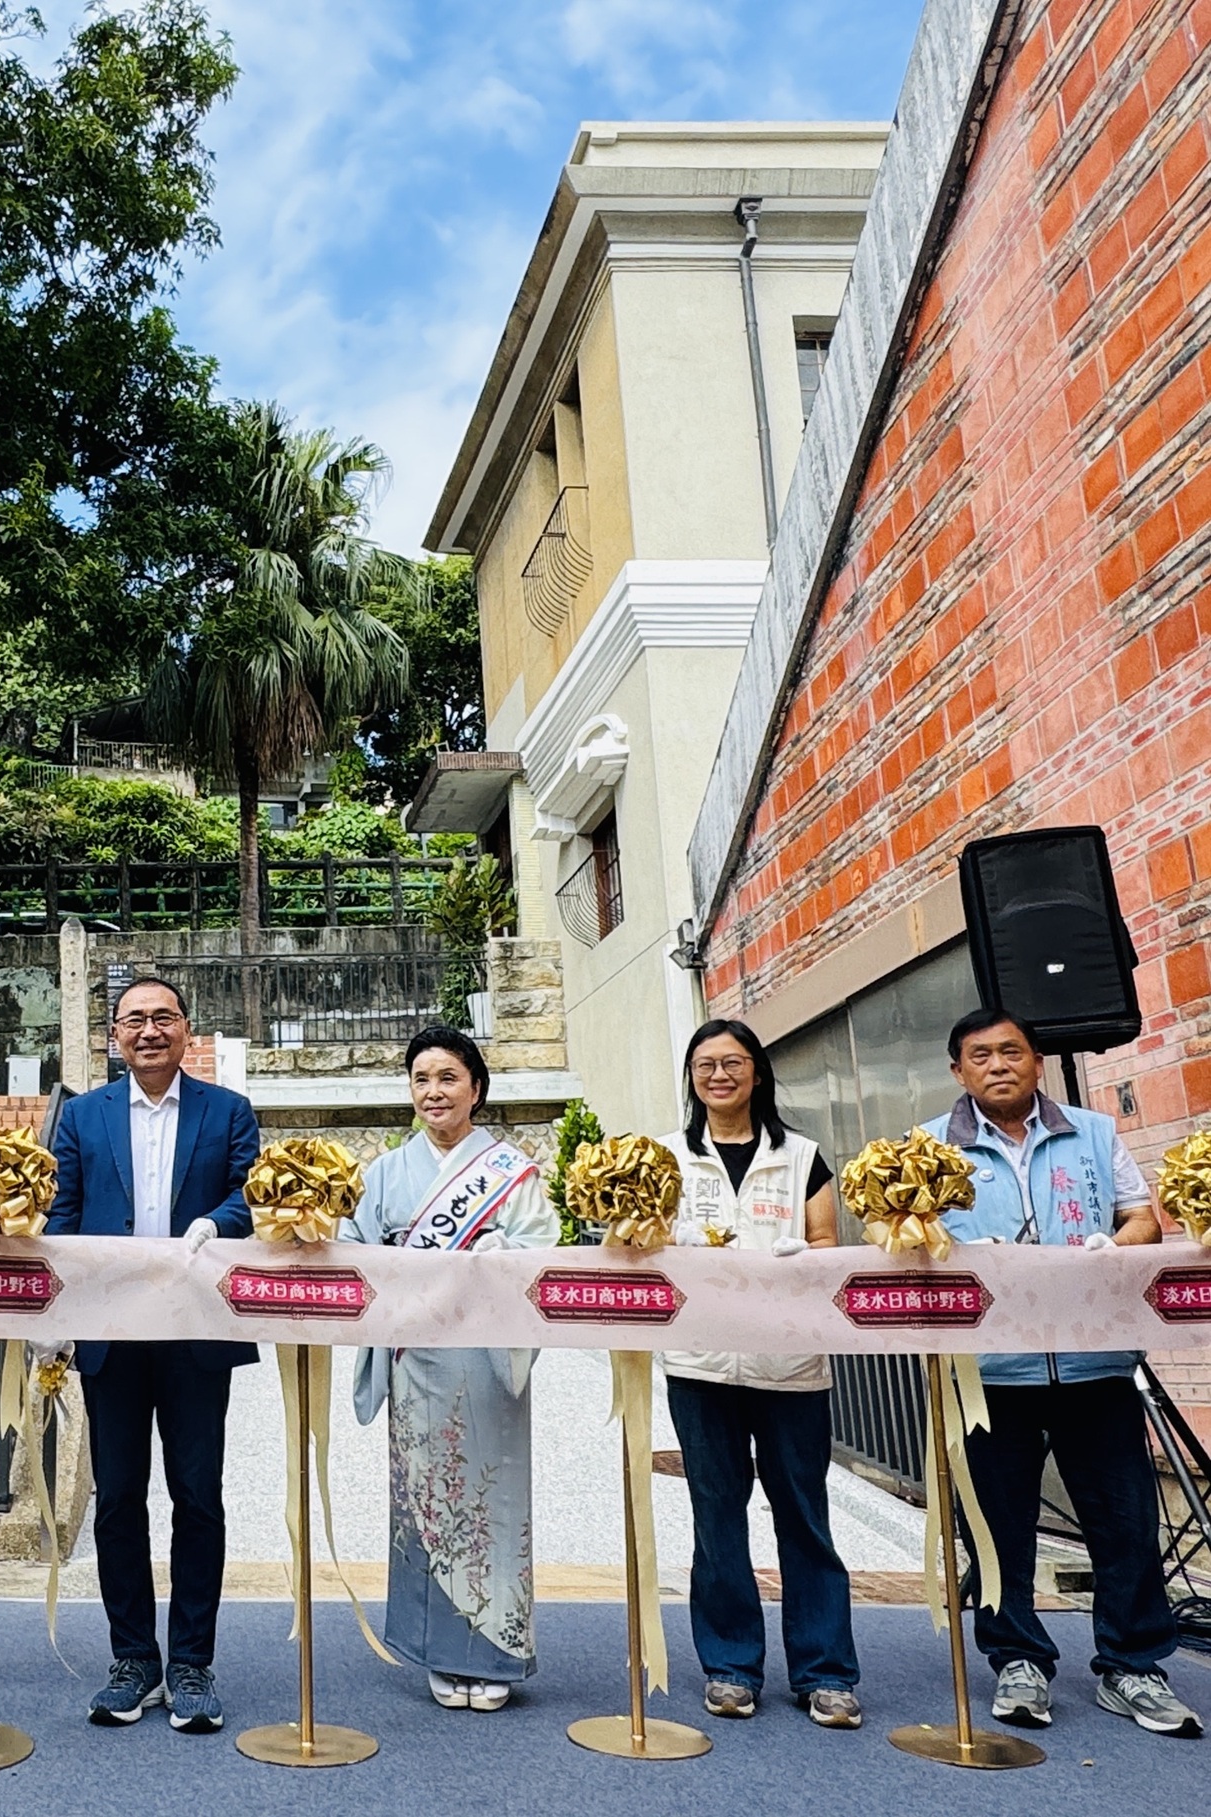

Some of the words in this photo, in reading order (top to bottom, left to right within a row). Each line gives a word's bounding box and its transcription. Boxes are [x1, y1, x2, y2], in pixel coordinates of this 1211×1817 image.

[1079, 1155, 1102, 1227] 新北市議員
[236, 1279, 358, 1303] 淡水日商中野宅
[545, 1285, 669, 1307] 淡水日商中野宅
[851, 1290, 976, 1310] 淡水日商中野宅
